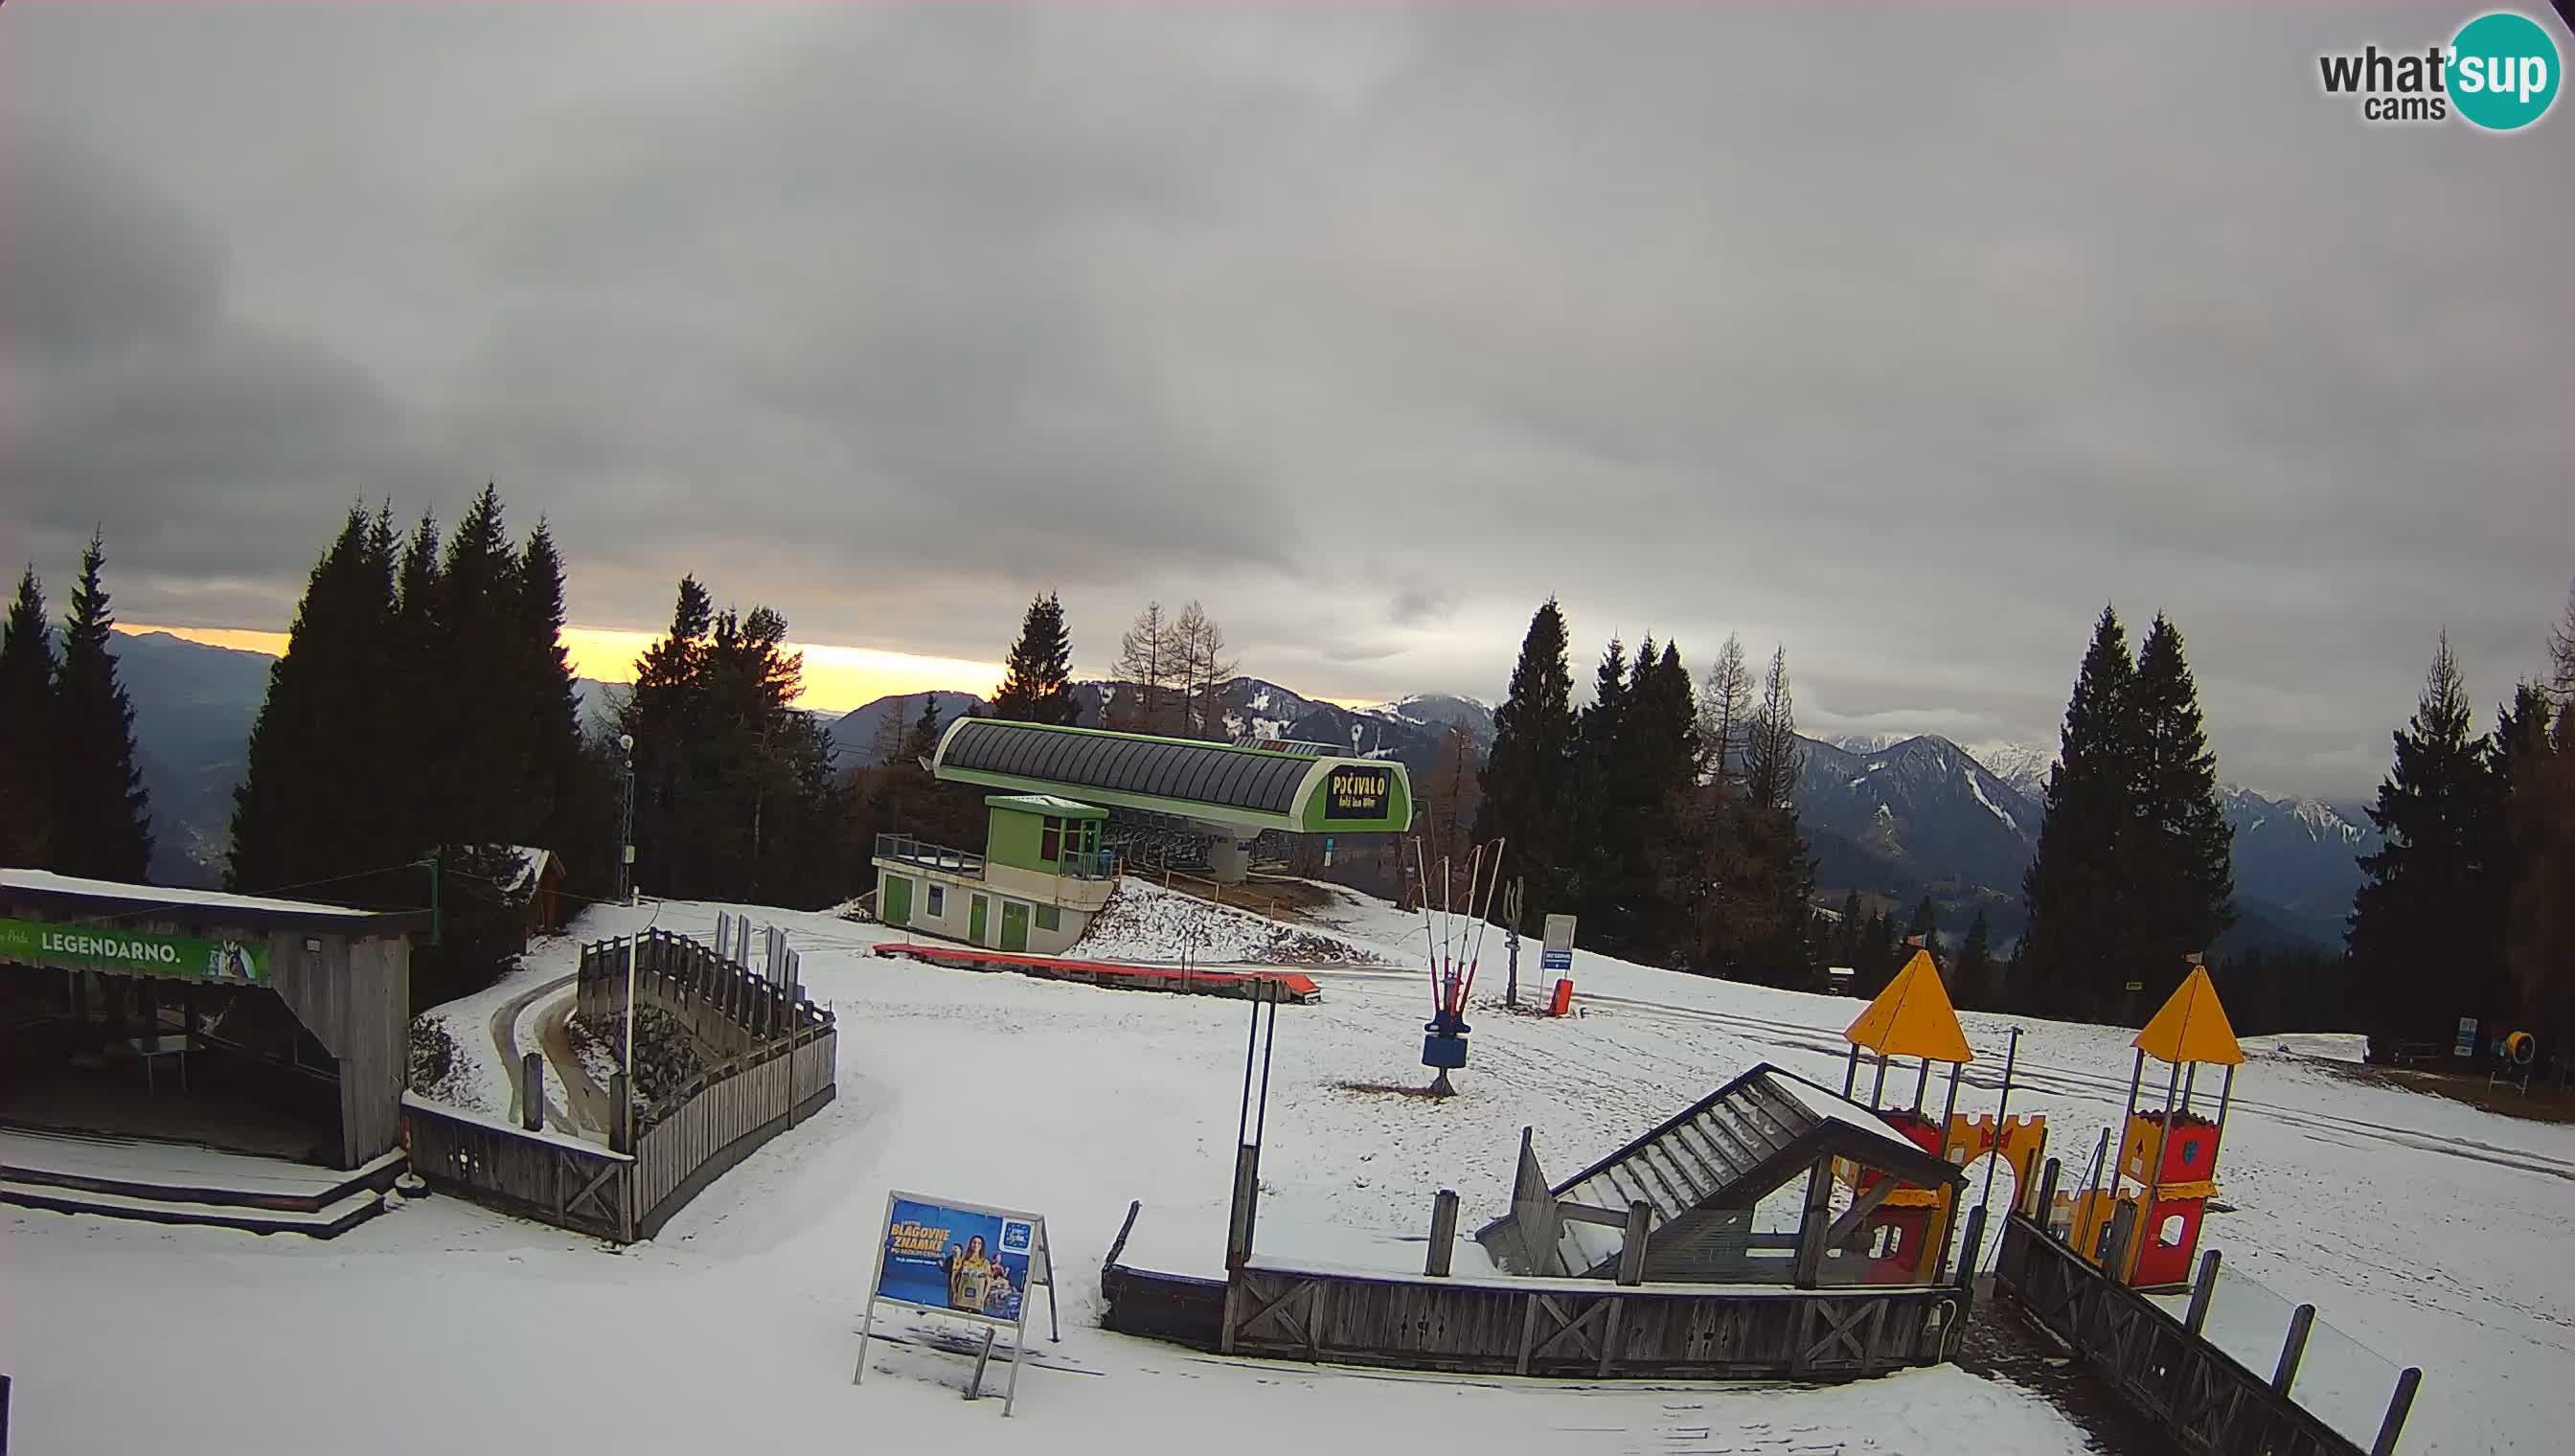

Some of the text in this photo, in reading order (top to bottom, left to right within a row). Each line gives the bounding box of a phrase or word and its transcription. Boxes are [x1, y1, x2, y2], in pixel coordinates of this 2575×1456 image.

[41, 931, 182, 965] LEGENDARNO.
[891, 1223, 951, 1241] BLAGOVNE
[893, 1236, 945, 1252] ZNAMKE
